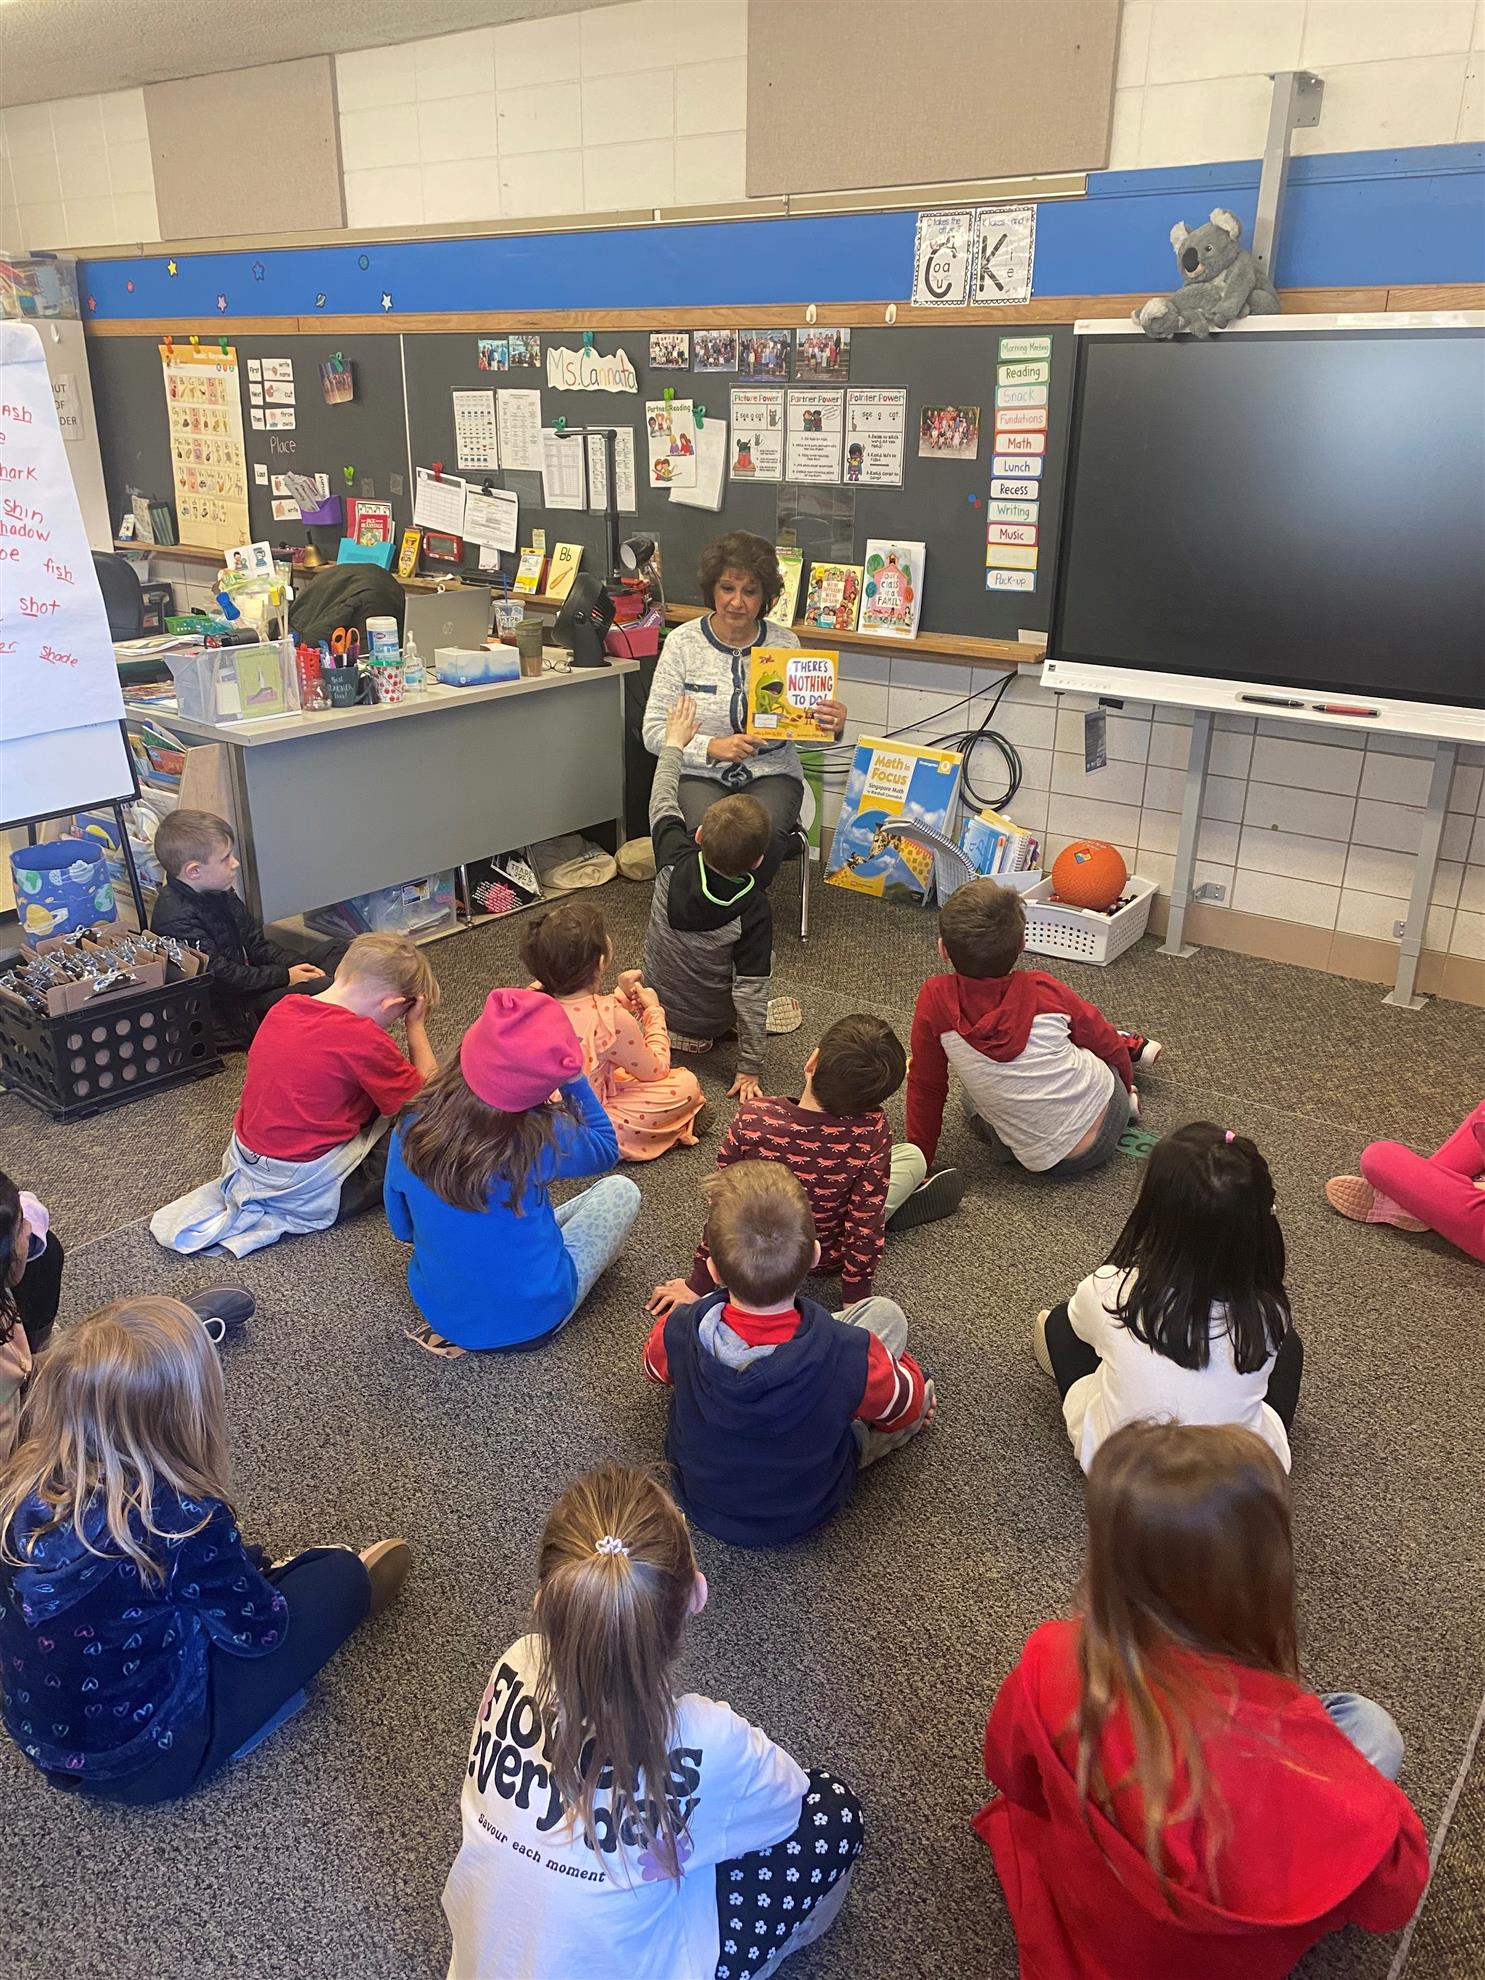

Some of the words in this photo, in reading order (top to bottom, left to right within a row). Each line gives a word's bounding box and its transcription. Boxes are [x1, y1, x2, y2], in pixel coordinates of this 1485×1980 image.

[979, 233, 1008, 292] K
[936, 279, 944, 290] u
[1001, 342, 1028, 354] Morning
[1006, 366, 1041, 380] Reading
[734, 394, 758, 402] Picture
[760, 394, 780, 402] Power
[790, 395, 816, 403] Partner
[850, 393, 876, 402] Pointer
[1004, 388, 1036, 403] Snack
[669, 404, 691, 413] Reading
[60, 416, 78, 426] DER
[270, 435, 296, 454] Place
[1008, 438, 1032, 450] Math
[1004, 460, 1030, 472] Lunch
[1000, 483, 1028, 495] Recess
[997, 504, 1030, 520] Writing
[1000, 528, 1024, 541] Music
[560, 546, 572, 562] Bb
[44, 558, 74, 583] fish
[995, 572, 1026, 588] Pack-up
[20, 596, 60, 616] shot
[792, 660, 828, 673] THERE'S
[792, 694, 806, 706] TO
[874, 755, 904, 771] Math
[868, 782, 892, 792] Singapore
[478, 1812, 508, 1844] Savour
[512, 1840, 542, 1864] each
[546, 1857, 608, 1884] moment
